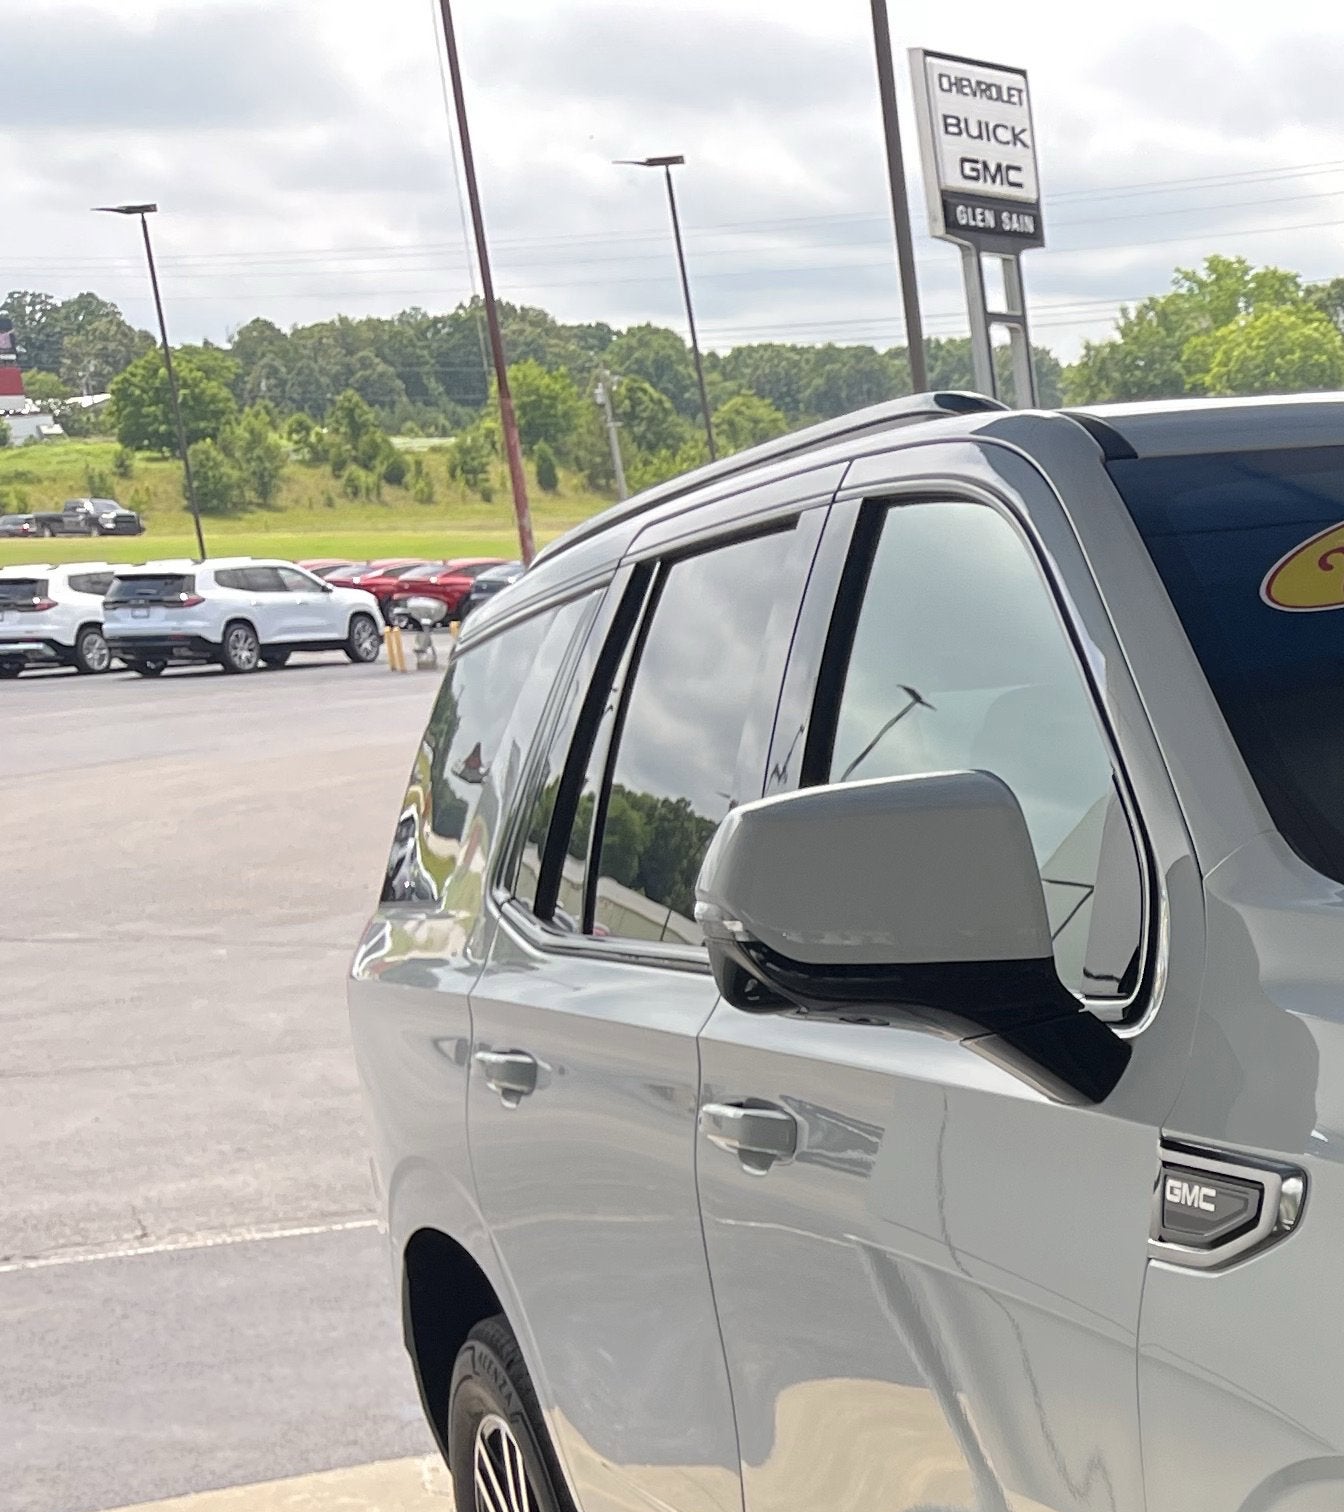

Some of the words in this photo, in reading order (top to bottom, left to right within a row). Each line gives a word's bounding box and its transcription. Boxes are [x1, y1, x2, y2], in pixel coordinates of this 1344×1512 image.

[938, 73, 1023, 107] CHEVROLET
[942, 114, 1030, 149] BUICK
[960, 157, 1023, 188] GMC
[956, 204, 996, 228] GLEN
[1001, 211, 1036, 234] SAIN
[1165, 1178, 1216, 1212] GMC
